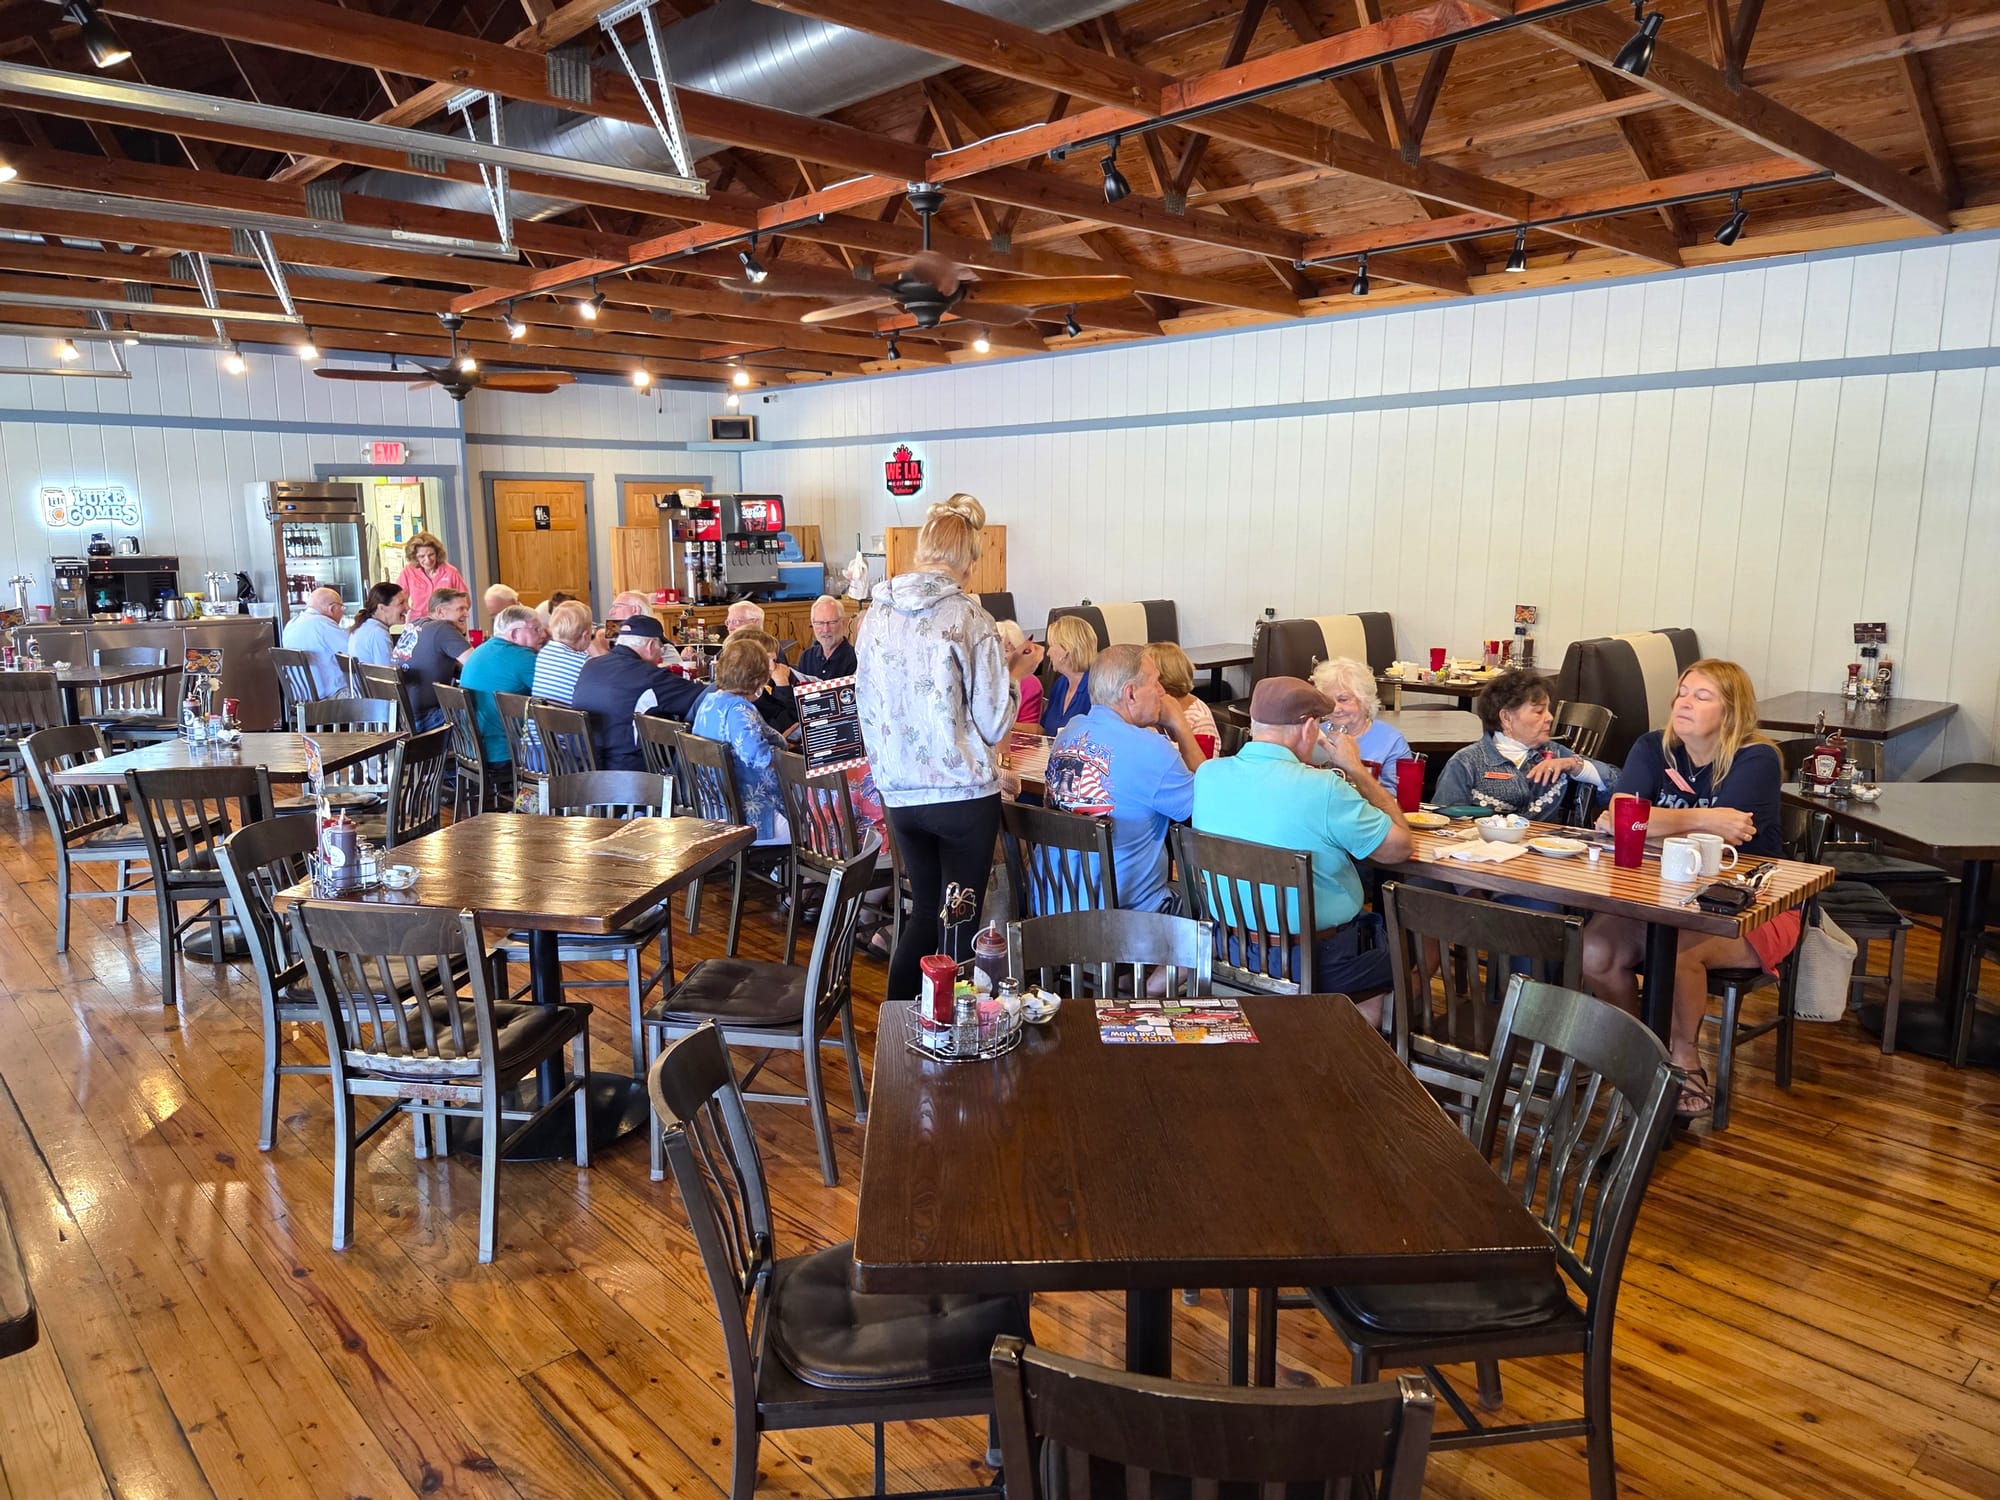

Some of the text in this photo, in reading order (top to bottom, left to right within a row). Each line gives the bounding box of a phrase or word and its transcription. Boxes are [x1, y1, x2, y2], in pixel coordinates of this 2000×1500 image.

[374, 443, 400, 462] EXIT
[886, 462, 902, 480] WE
[71, 488, 126, 506] LUKE
[67, 505, 139, 526] COMBS
